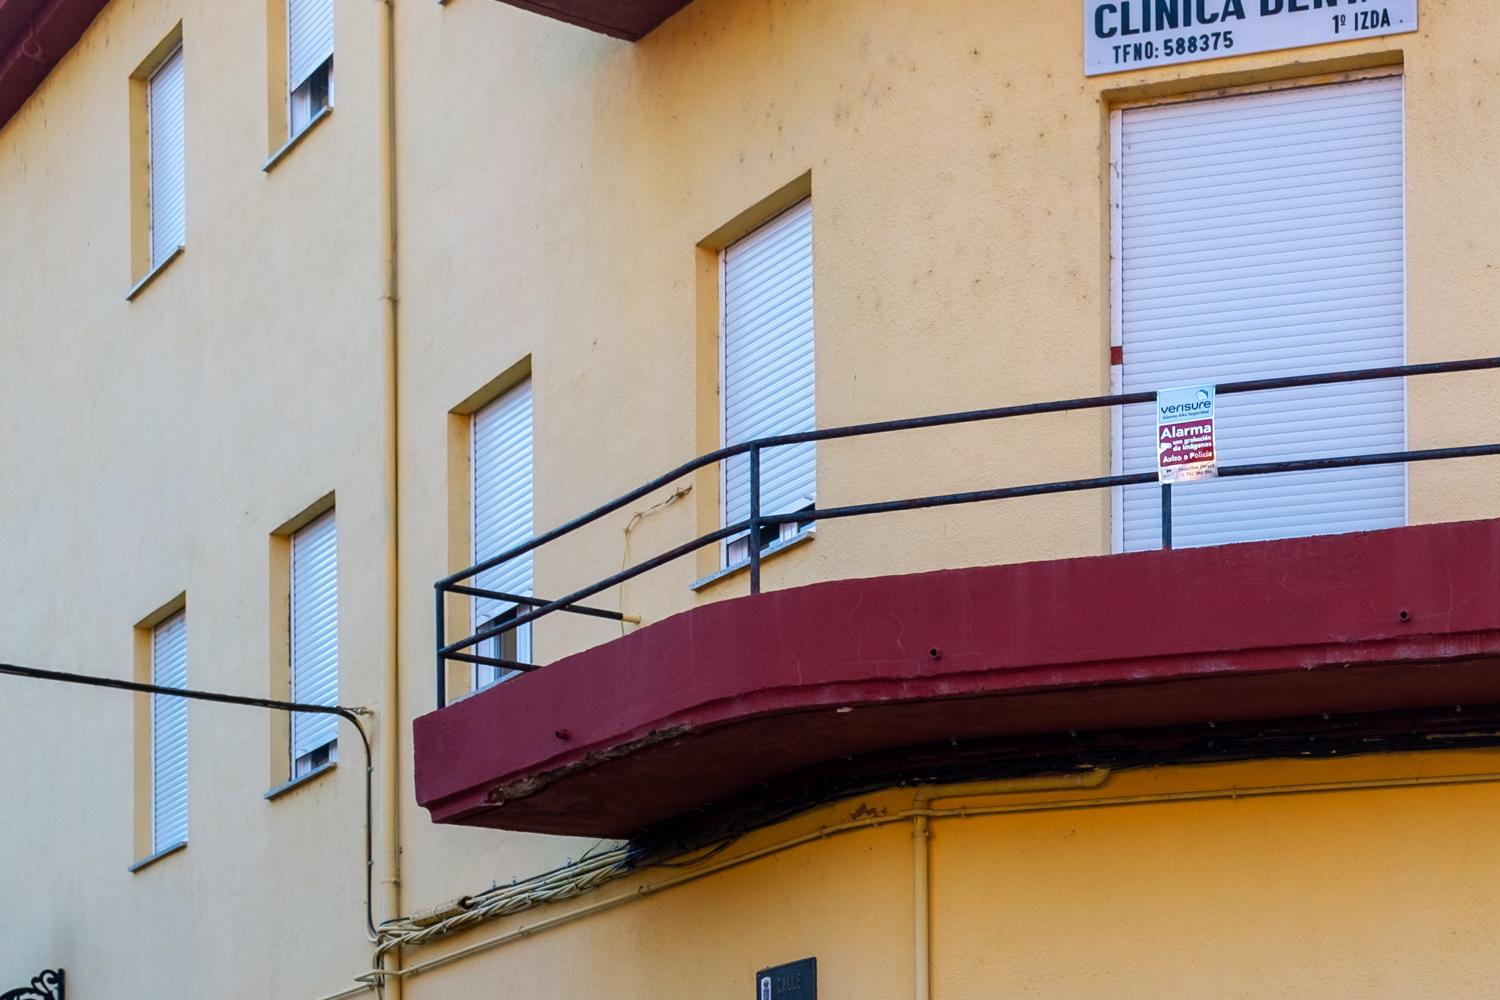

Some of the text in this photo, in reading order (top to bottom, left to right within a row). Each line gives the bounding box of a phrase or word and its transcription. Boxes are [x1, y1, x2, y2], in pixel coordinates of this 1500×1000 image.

[1094, 0, 1245, 39] CLINICA
[1354, 8, 1391, 31] IZDA
[1163, 31, 1234, 57] 588375
[1160, 400, 1212, 415] verisure
[1160, 424, 1212, 440] Alarma
[1162, 454, 1182, 463] Aviso
